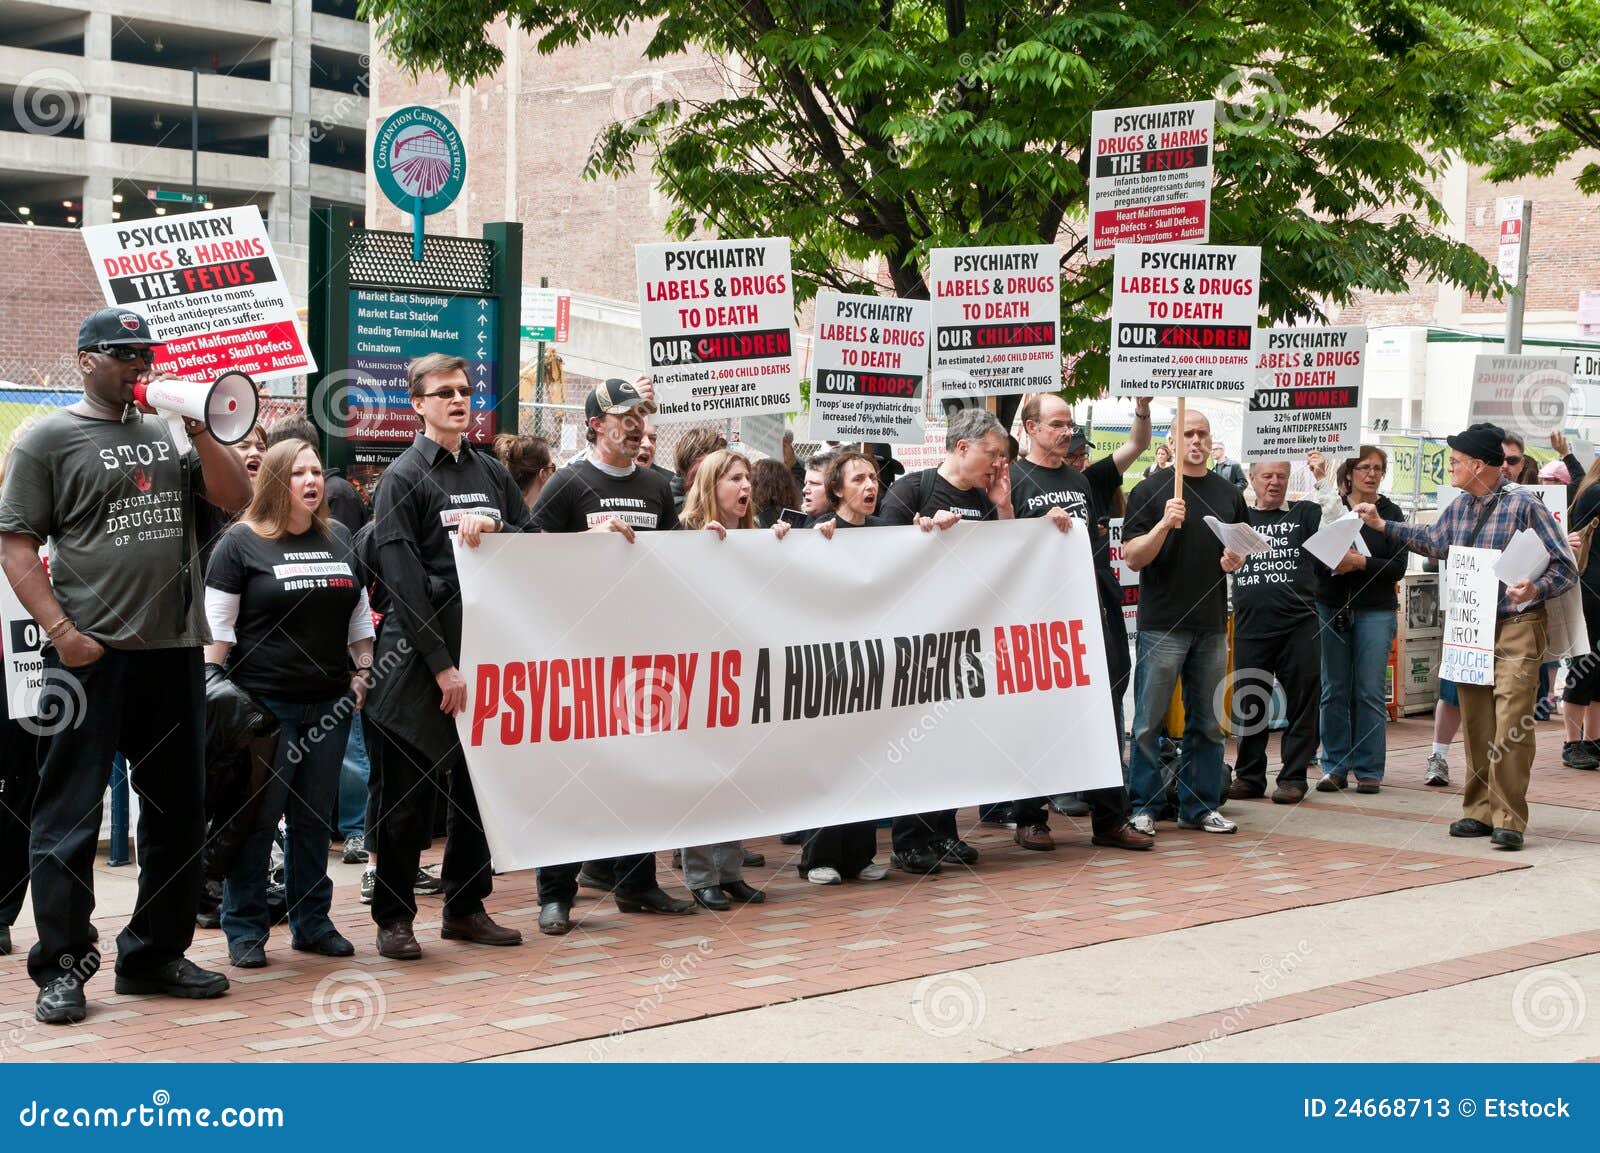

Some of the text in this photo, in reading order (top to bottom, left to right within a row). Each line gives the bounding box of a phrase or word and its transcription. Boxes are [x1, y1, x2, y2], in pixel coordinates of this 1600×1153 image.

[1114, 109, 1194, 132] PSYCHIATRY
[1098, 128, 1208, 155] DRUGS HARMS
[1111, 149, 1194, 174] THE FETUS
[1114, 176, 1139, 186] Infants
[1141, 174, 1157, 183] born
[1168, 171, 1188, 179] moms
[1096, 180, 1205, 200] prescribed antidepressants during
[1114, 191, 1188, 208] pregnancy can suffer:
[1117, 206, 1185, 220] Heart Malformation
[117, 216, 233, 249] PSYCHIATRY
[1102, 216, 1198, 235] Lung Defects Skull Defects
[1137, 231, 1172, 242] Symptoms
[1181, 228, 1204, 237] Autism
[104, 238, 265, 277] DRUGS HARMS
[665, 247, 765, 271] PSYCHIATRY
[955, 253, 1038, 272] PSYCHIATRY
[1141, 252, 1237, 270] PSYCHIATRY
[131, 262, 255, 299] THE FETUS
[647, 275, 786, 301] LABELS DRUGS
[938, 277, 1054, 297] LABELS DRUGS
[1121, 277, 1252, 295] LABELS DRUGS
[358, 291, 448, 307] Market East Shopping
[358, 309, 438, 322] Market East Station
[679, 305, 758, 328] TO DEATH
[837, 301, 913, 322] PSYCHIATRY
[1148, 302, 1222, 319] TO DEATH
[358, 325, 458, 339] Reading Terminal Market
[820, 323, 924, 347] LABELS DRUGS
[1120, 327, 1248, 346] OUR CHILDREN
[1269, 332, 1347, 348] PSYCHIATRY
[166, 329, 267, 355] Heart Malformation
[357, 343, 400, 353] Chinatown
[652, 332, 788, 362] OUR CHILDREN
[357, 360, 402, 370] WASHINGTON
[842, 350, 901, 368] TO DEATH
[1256, 351, 1360, 368] ABELS DRUGS
[357, 377, 398, 386] Avenue of
[653, 364, 790, 383] An estimated 2,600 CHILD DEATHS
[1275, 371, 1335, 387] TO DEATH
[692, 382, 756, 396] every year are
[826, 373, 913, 394] OUR TROOPS
[660, 393, 790, 414] linked to PSYCHIATRIC DRUGS
[1260, 390, 1349, 408] OUR WOMEN
[842, 401, 854, 409] use
[856, 401, 863, 410] of
[864, 402, 901, 415] psychiatric
[902, 402, 921, 414] drugs
[391, 413, 420, 421] DISTRIC
[822, 412, 912, 425] increased their
[1274, 412, 1331, 422] 32% of WOMEN
[356, 428, 413, 438] Independence
[837, 426, 864, 435] suicides
[882, 428, 899, 437] 80%.
[1257, 423, 1347, 435] taking ANTIDEPRESSANTS
[1298, 435, 1317, 445] likely
[1328, 434, 1339, 442] DIE
[100, 441, 169, 470] STOP
[600, 498, 646, 508] PSYCHIATRY:
[107, 508, 181, 533] DRUGGIN
[115, 535, 130, 546] OF
[1254, 561, 1297, 572] SCHOOL
[284, 579, 315, 590] DRUGS
[316, 579, 327, 588] TO
[1237, 575, 1259, 586] NEAR
[471, 619, 1090, 747] PSYCHIATRY IS A HUMAN RIGHTS ABUSE
